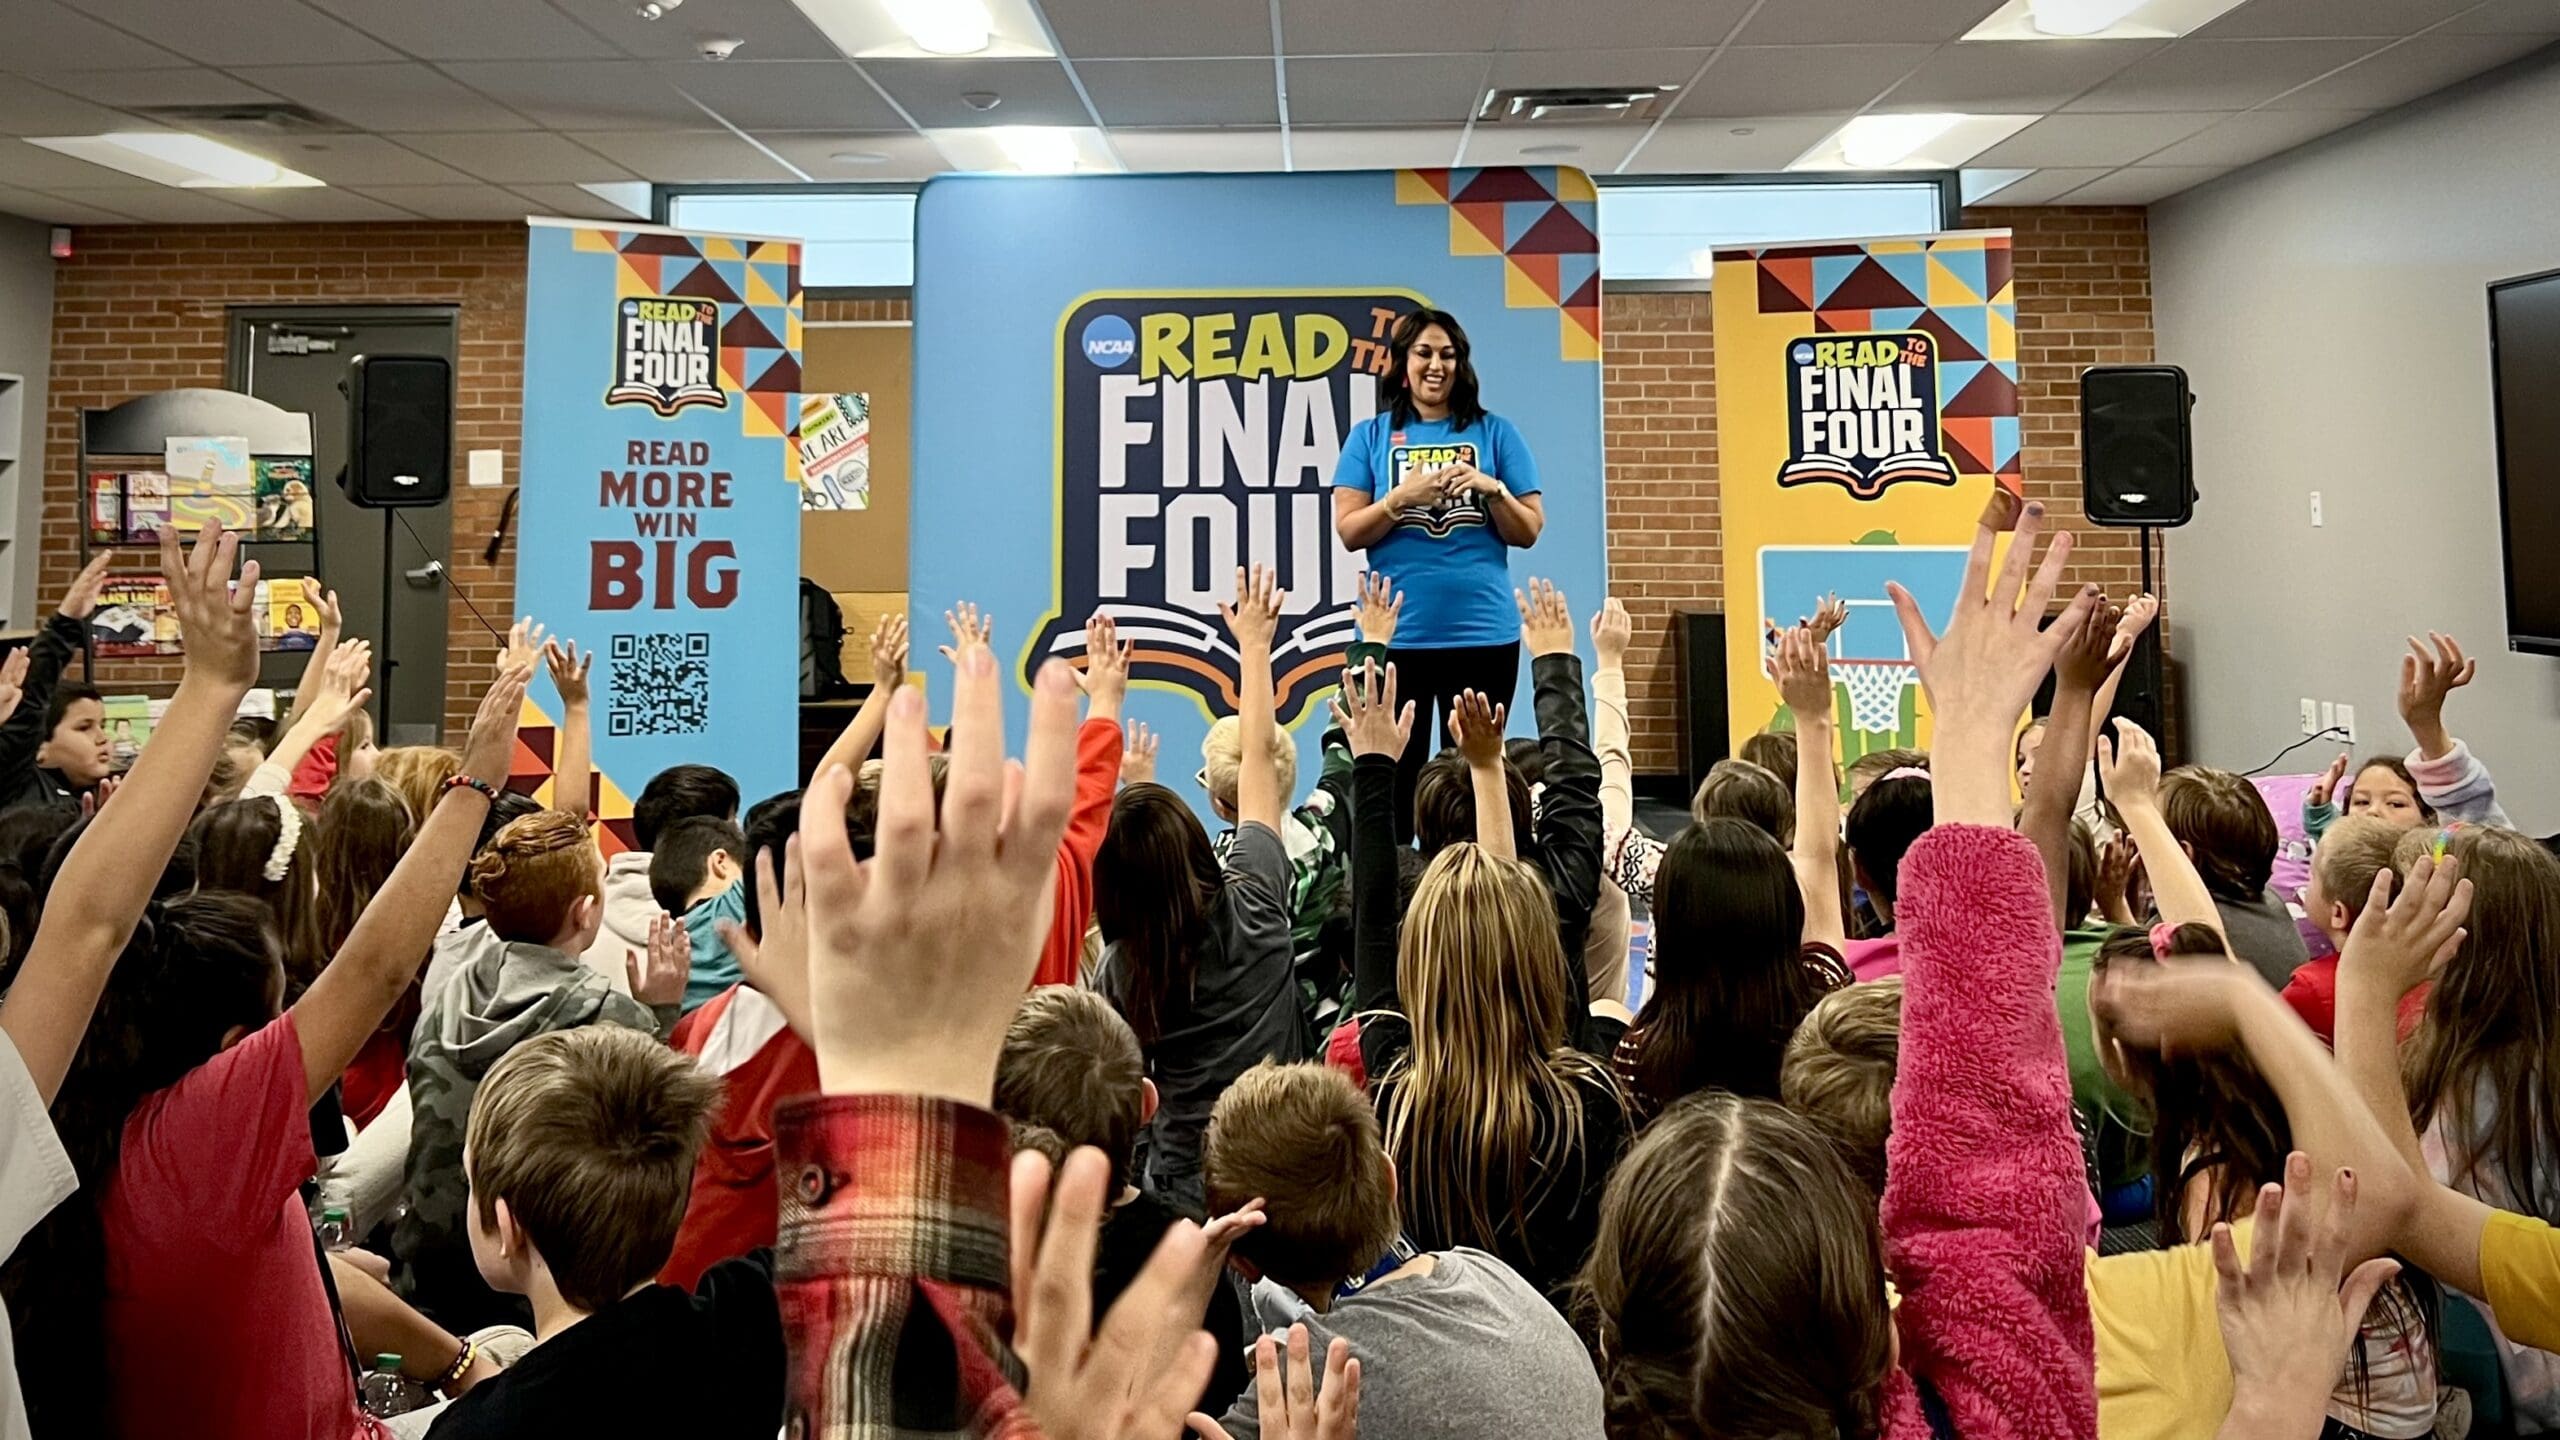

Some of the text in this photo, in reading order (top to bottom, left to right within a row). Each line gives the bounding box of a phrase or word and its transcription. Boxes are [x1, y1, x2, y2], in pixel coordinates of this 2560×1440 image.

[639, 301, 696, 322] READ
[702, 304, 714, 315] TO
[1371, 307, 1407, 340] T
[626, 317, 709, 354] FINAL
[1088, 340, 1134, 354] NCAA
[1140, 312, 1349, 380] READ
[1906, 337, 1927, 351] TO
[626, 350, 709, 387] FOUR
[1351, 339, 1392, 377] TH
[1815, 341, 1899, 369] READ
[1899, 350, 1927, 367] THE
[1800, 364, 1923, 410] FINAL
[820, 423, 848, 453] ARE
[1802, 410, 1925, 459] FOUR
[627, 440, 710, 466] READ
[1408, 448, 1456, 464] READ
[600, 471, 734, 508] MORE
[633, 512, 697, 537] WIN
[588, 540, 741, 610] BIG
